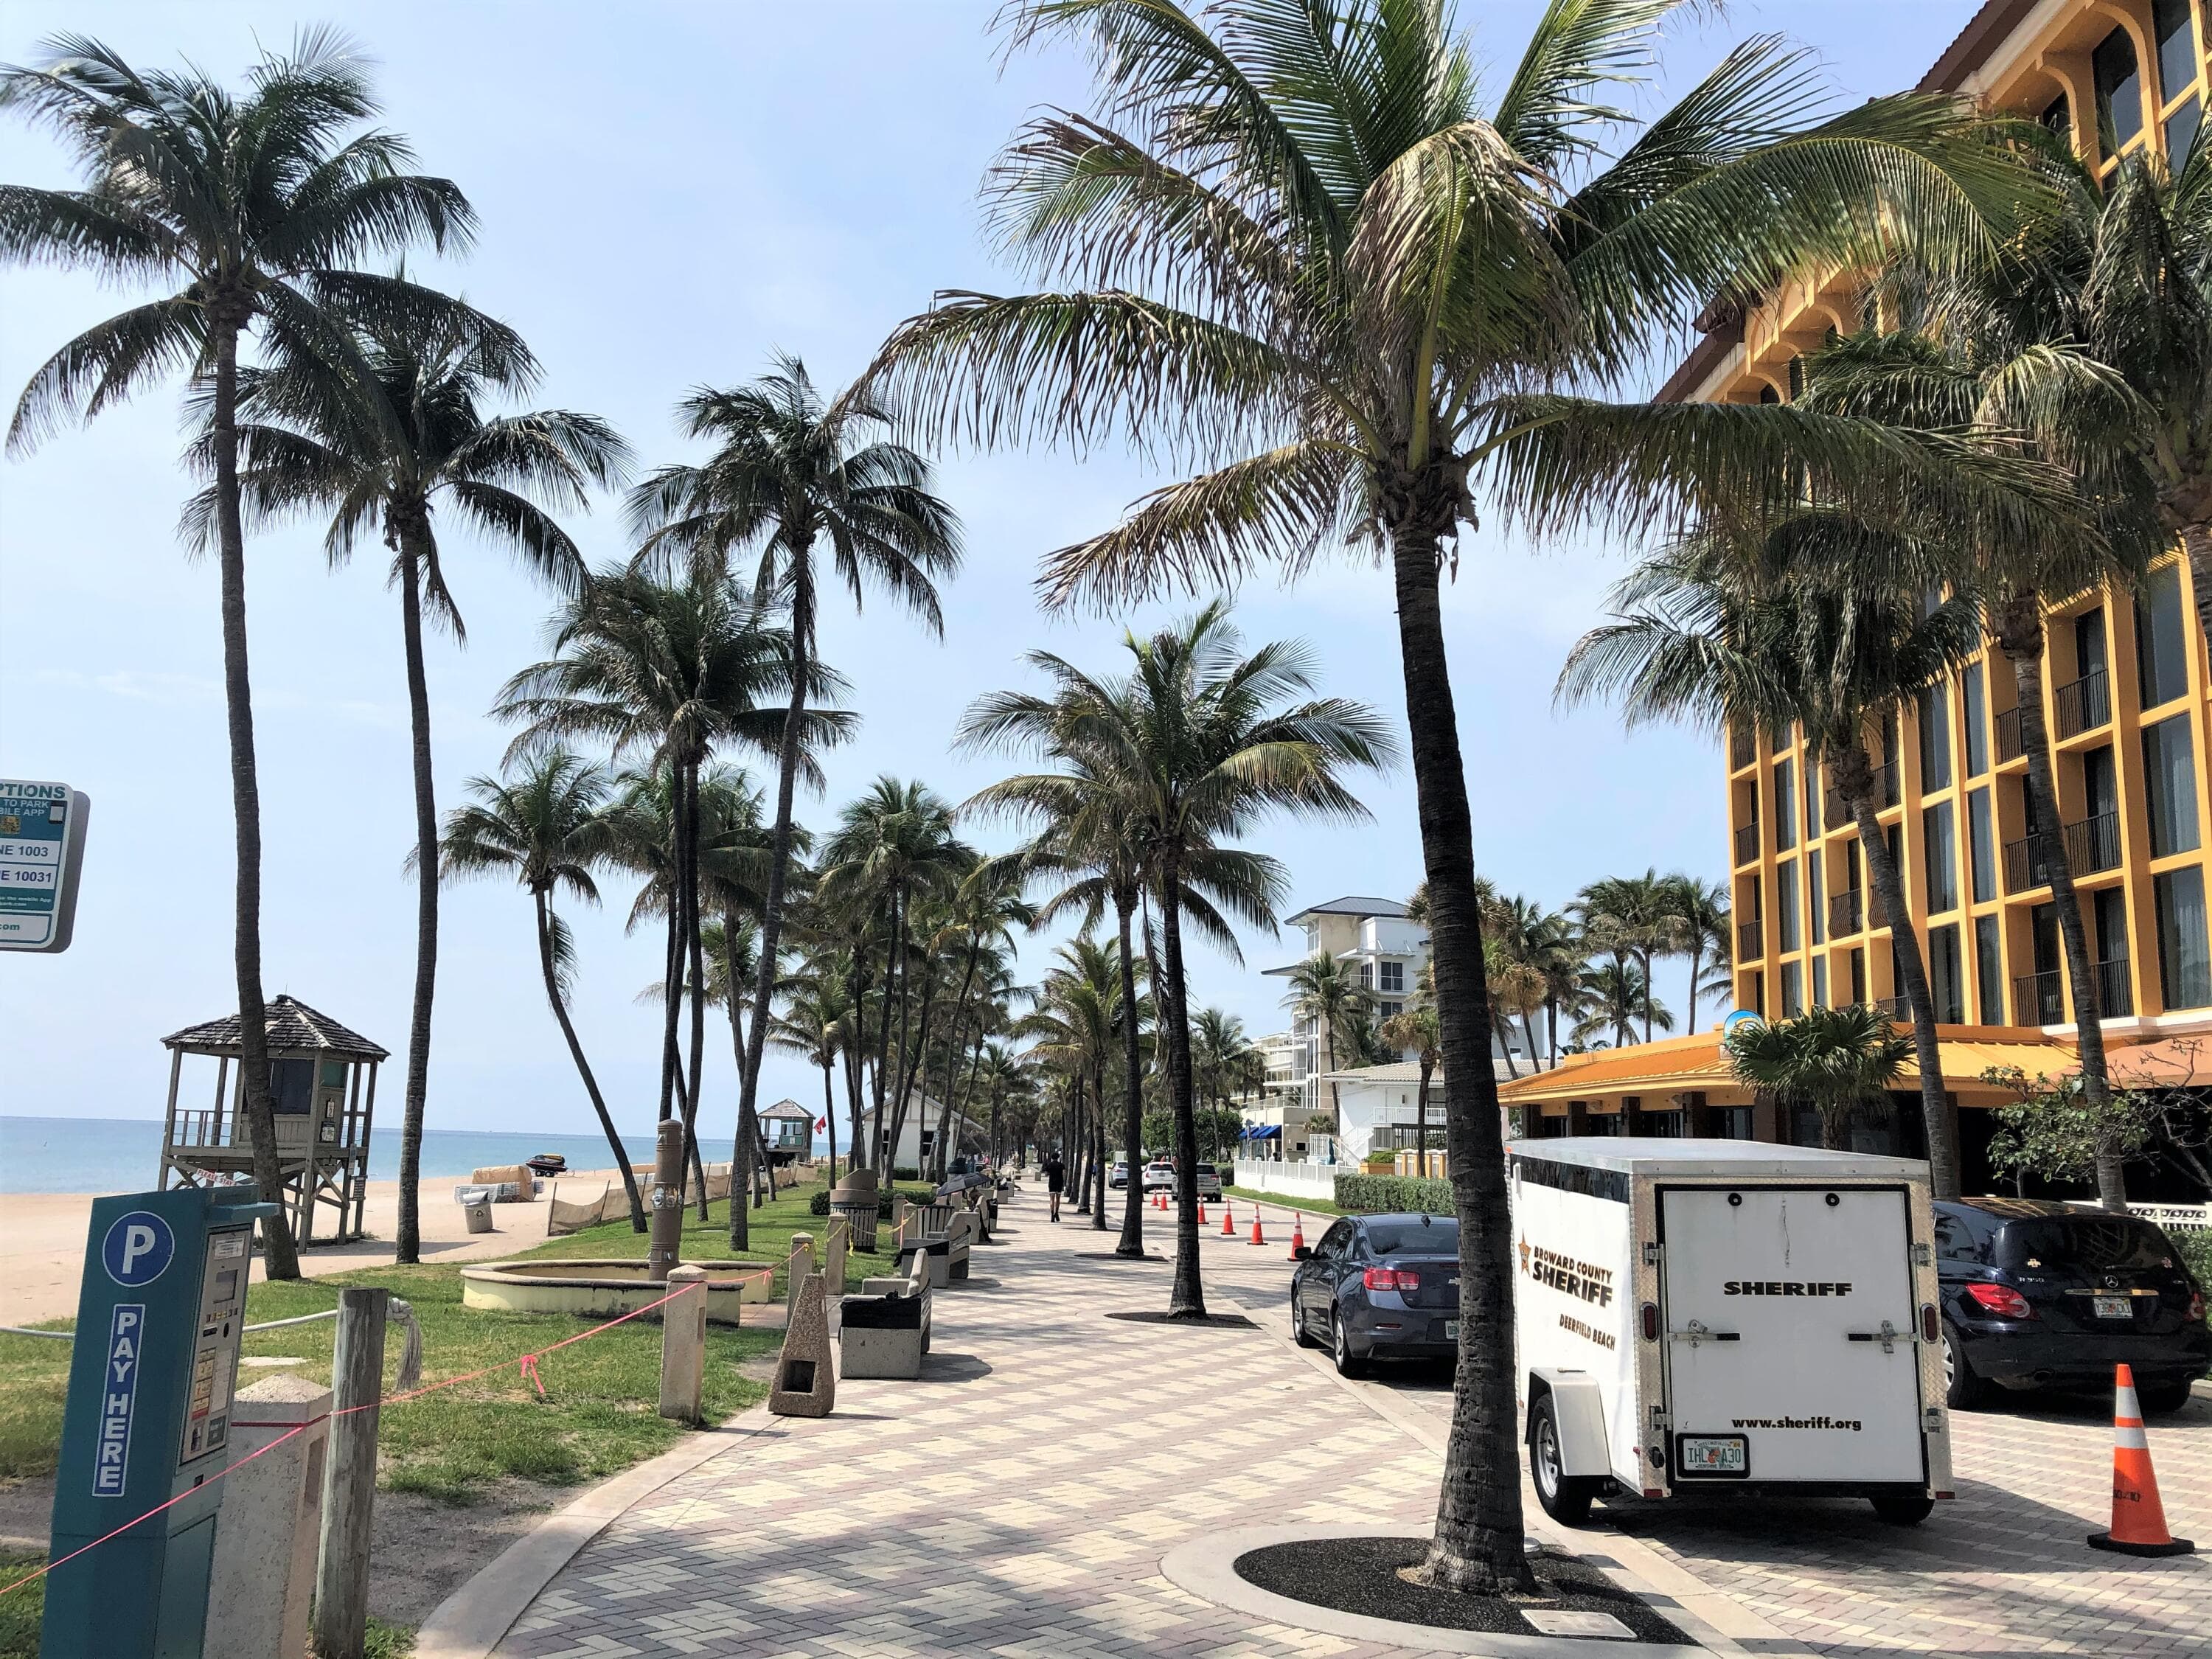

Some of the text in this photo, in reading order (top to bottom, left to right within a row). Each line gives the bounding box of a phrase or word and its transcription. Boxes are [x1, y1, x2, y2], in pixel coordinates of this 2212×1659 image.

[4, 799, 49, 809] TO PARK
[18, 846, 49, 857] 1003
[15, 871, 52, 883] 10031
[122, 1225, 156, 1274] P
[1534, 1245, 1613, 1284] BROWARD COUNTY
[1532, 1260, 1613, 1309] SHERIFF
[1724, 1281, 1852, 1297] SHERIFF
[1559, 1313, 1616, 1352] DEERFIELD BEACH
[99, 1312, 138, 1488] PAY HERE
[1731, 1416, 1863, 1432] www.sheriff.org
